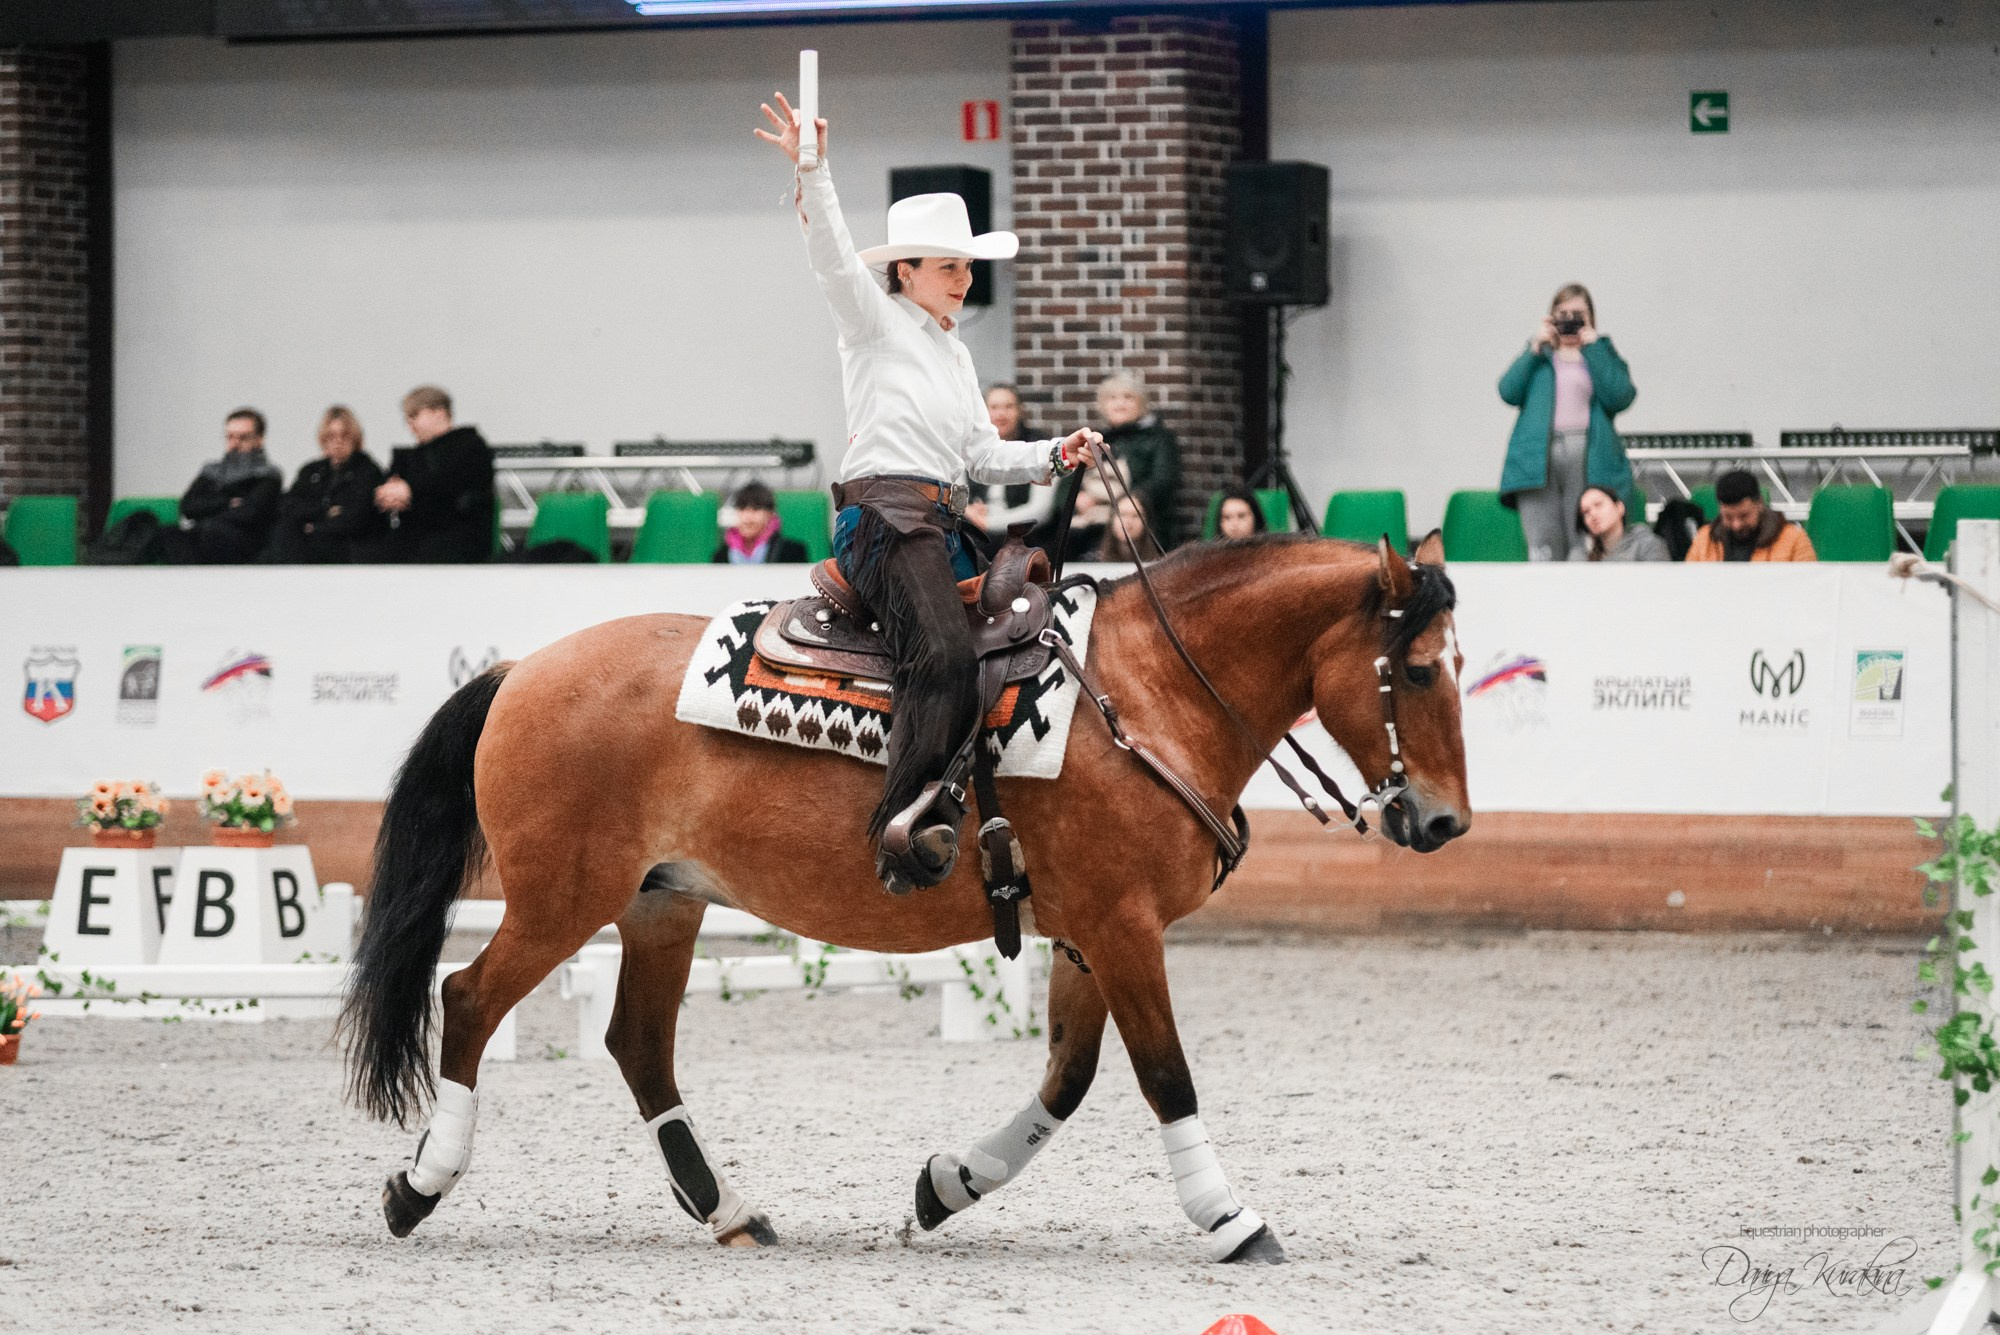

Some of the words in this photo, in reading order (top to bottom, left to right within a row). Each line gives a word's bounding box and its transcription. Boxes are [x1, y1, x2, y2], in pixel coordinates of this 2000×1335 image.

[1593, 688, 1692, 711] ЭКЛИПС
[1594, 673, 1692, 689] КРЫЛАТЫЙ
[78, 868, 116, 935] E
[194, 870, 235, 938] B
[272, 869, 306, 938] B
